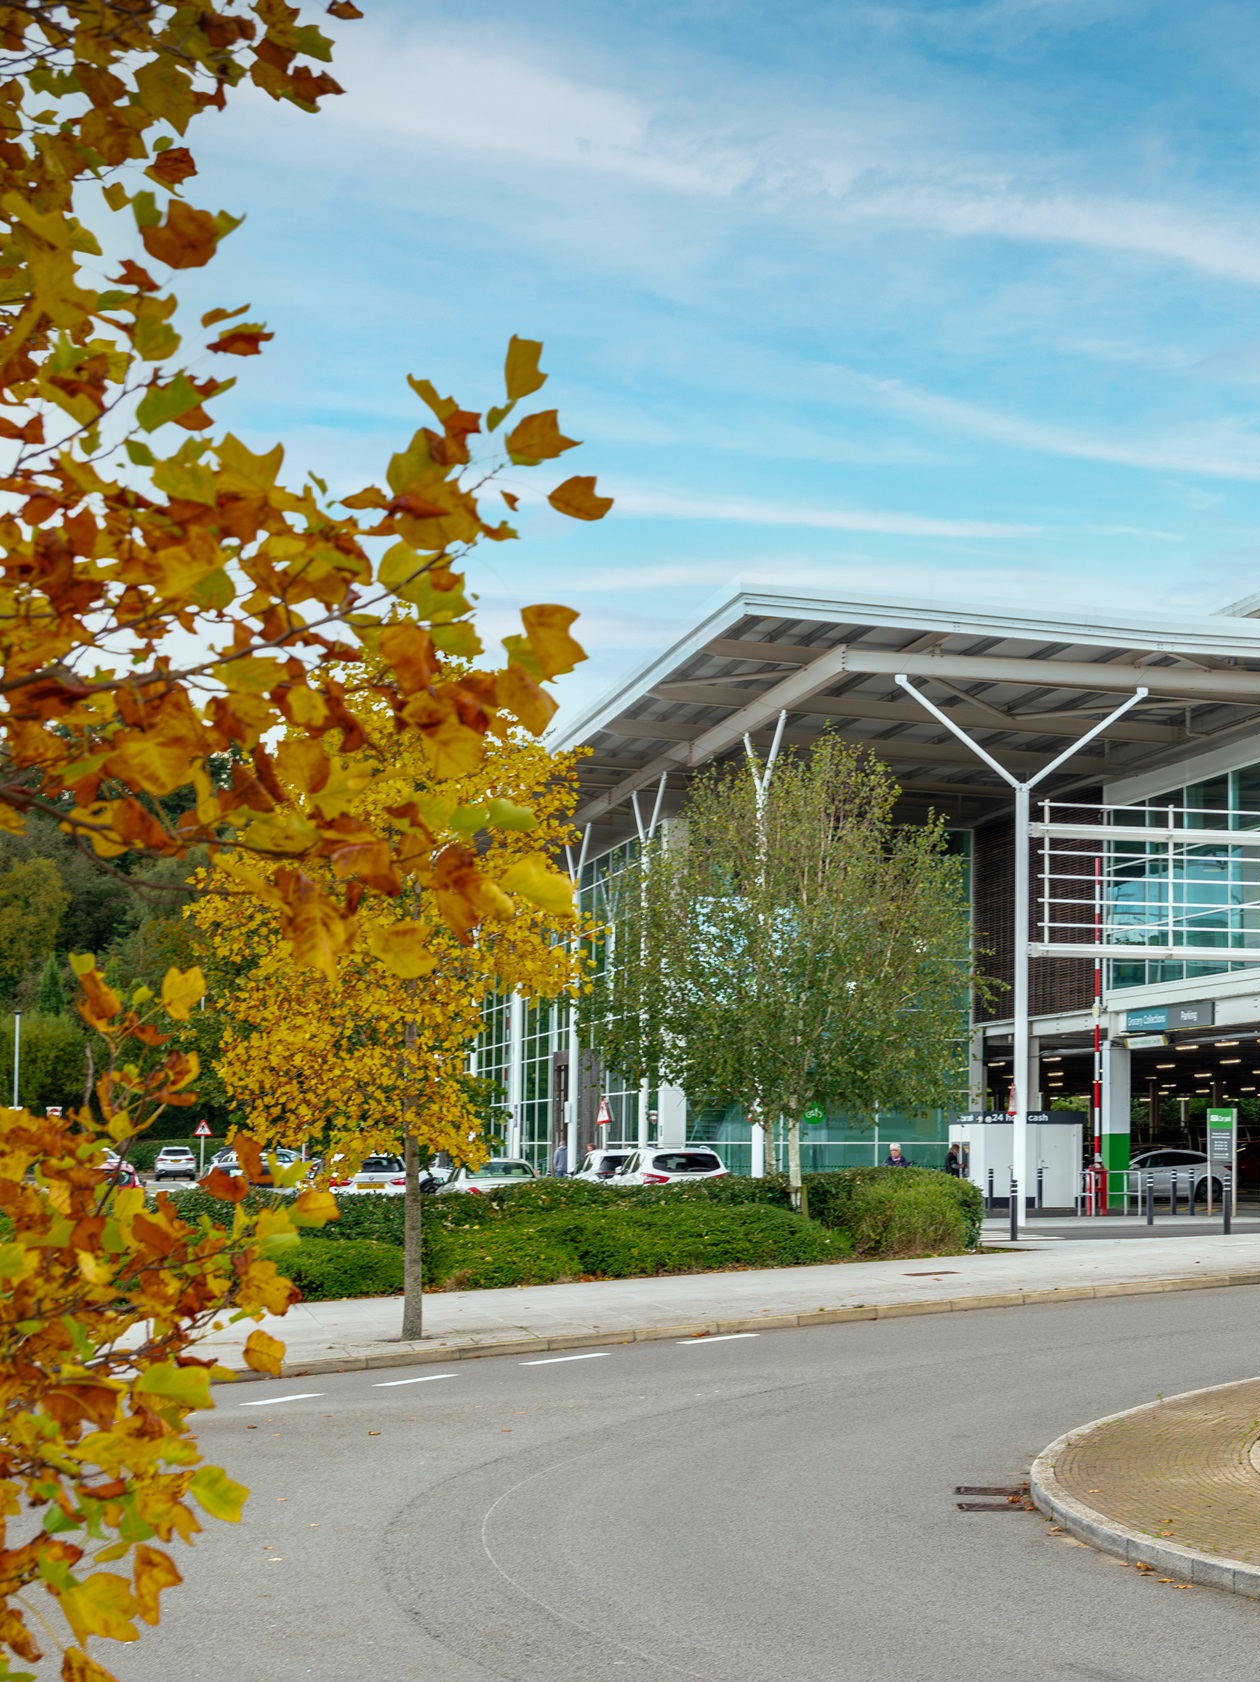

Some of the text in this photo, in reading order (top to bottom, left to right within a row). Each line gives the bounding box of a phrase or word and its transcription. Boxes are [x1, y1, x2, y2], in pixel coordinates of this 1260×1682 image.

[1127, 1014, 1166, 1026] Grocery Collections
[1180, 1010, 1198, 1021] Parking
[1028, 1113, 1049, 1122] cash
